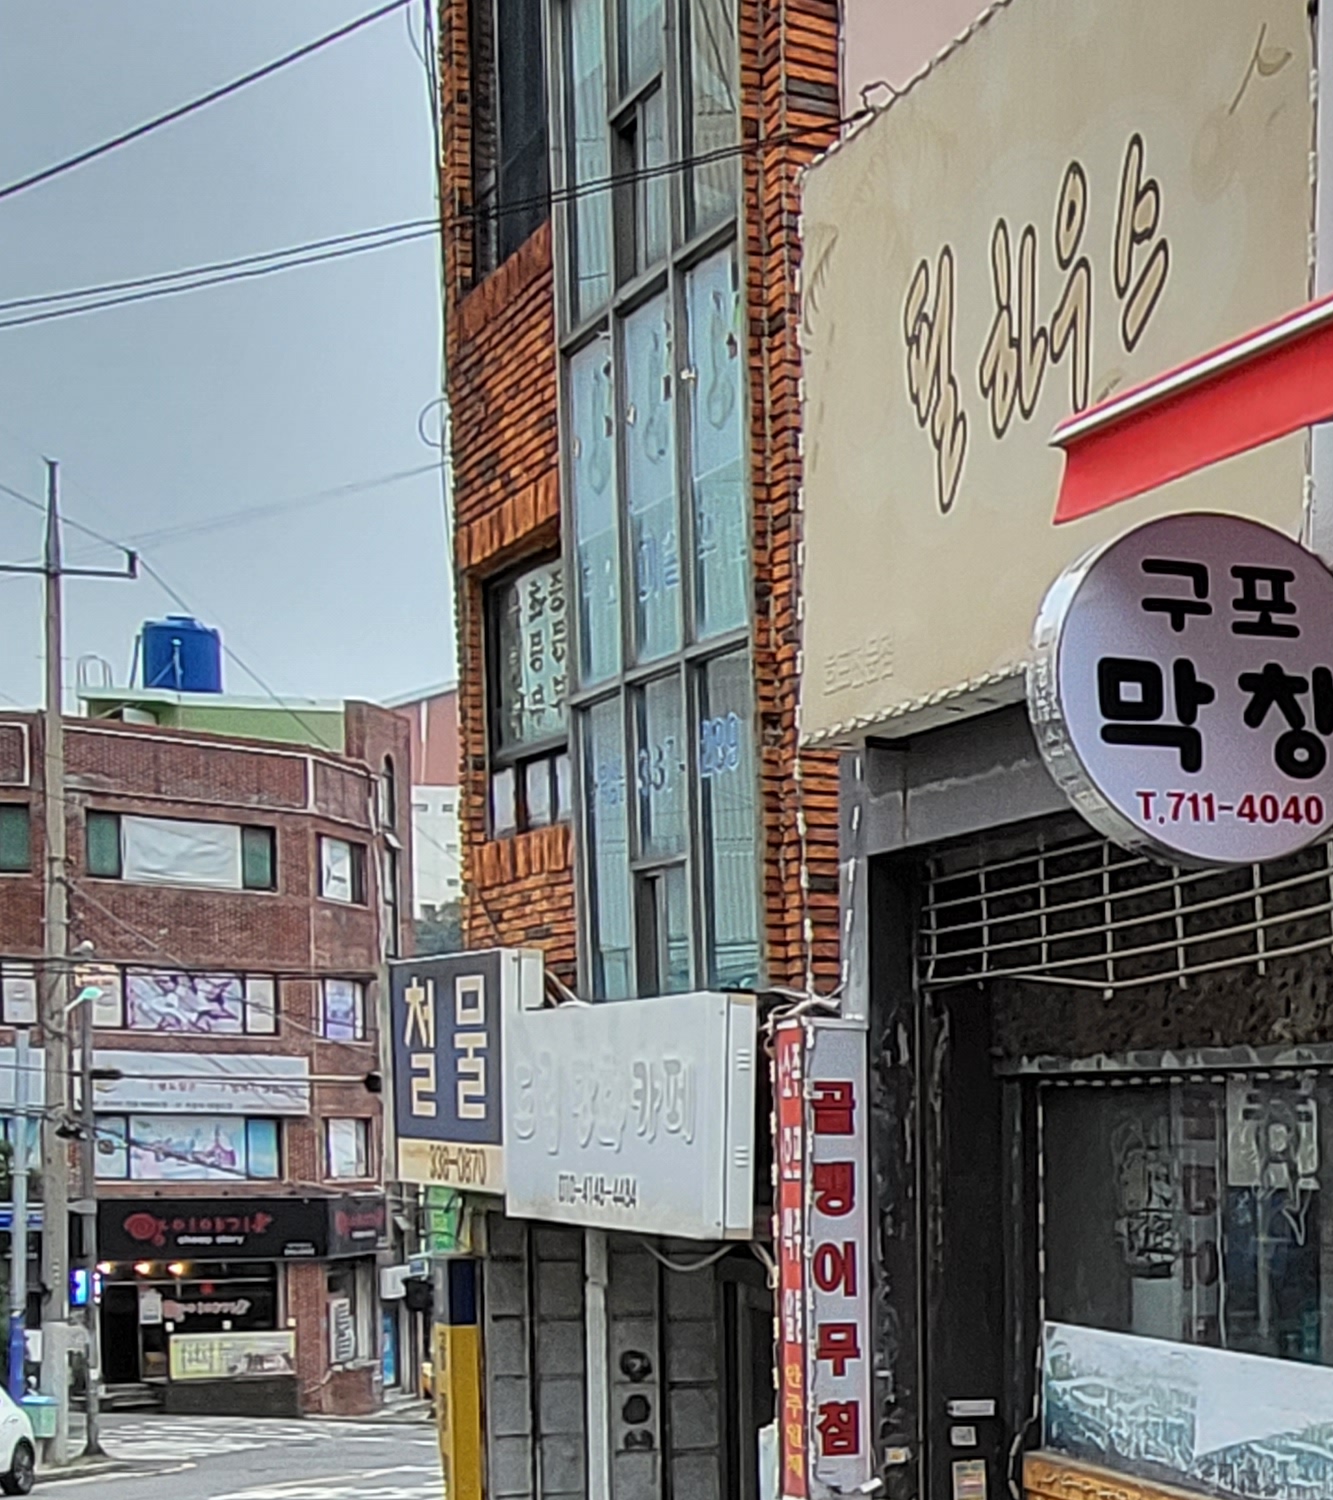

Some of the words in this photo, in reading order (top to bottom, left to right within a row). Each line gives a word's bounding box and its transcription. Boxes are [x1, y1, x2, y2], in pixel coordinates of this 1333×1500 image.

[1141, 558, 1300, 639] 구포
[1136, 790, 1324, 827] T.711-4040
[404, 974, 488, 1120] 철물
